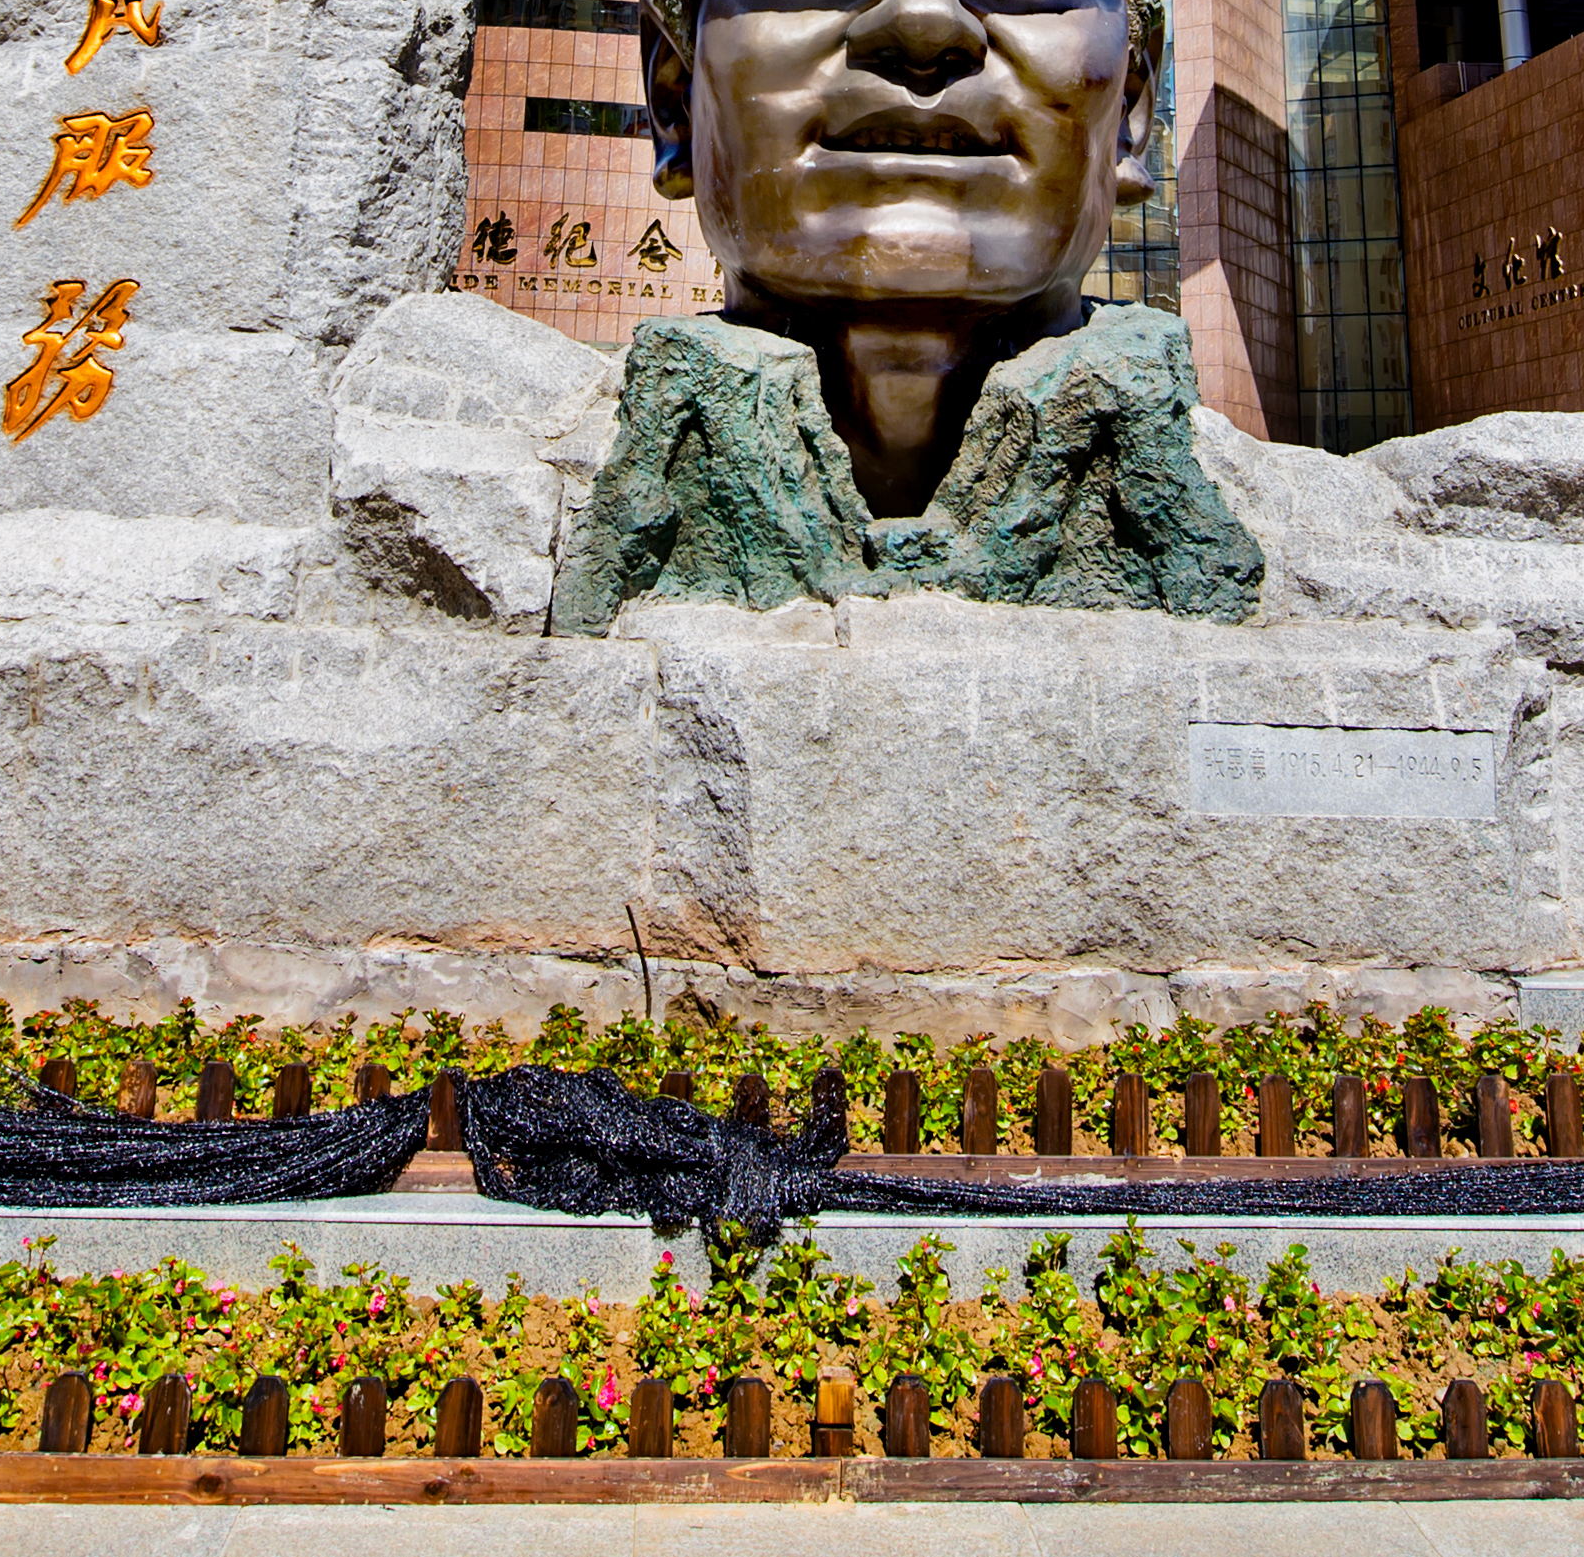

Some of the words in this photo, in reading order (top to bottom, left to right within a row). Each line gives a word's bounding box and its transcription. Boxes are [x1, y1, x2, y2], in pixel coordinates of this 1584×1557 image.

[471, 210, 722, 279] 德纪念
[1472, 226, 1565, 298] 文化馆
[451, 274, 499, 290] IDE
[518, 276, 673, 300] MEMORIAL
[691, 287, 724, 303] HA
[1458, 301, 1523, 330] CULTURAL
